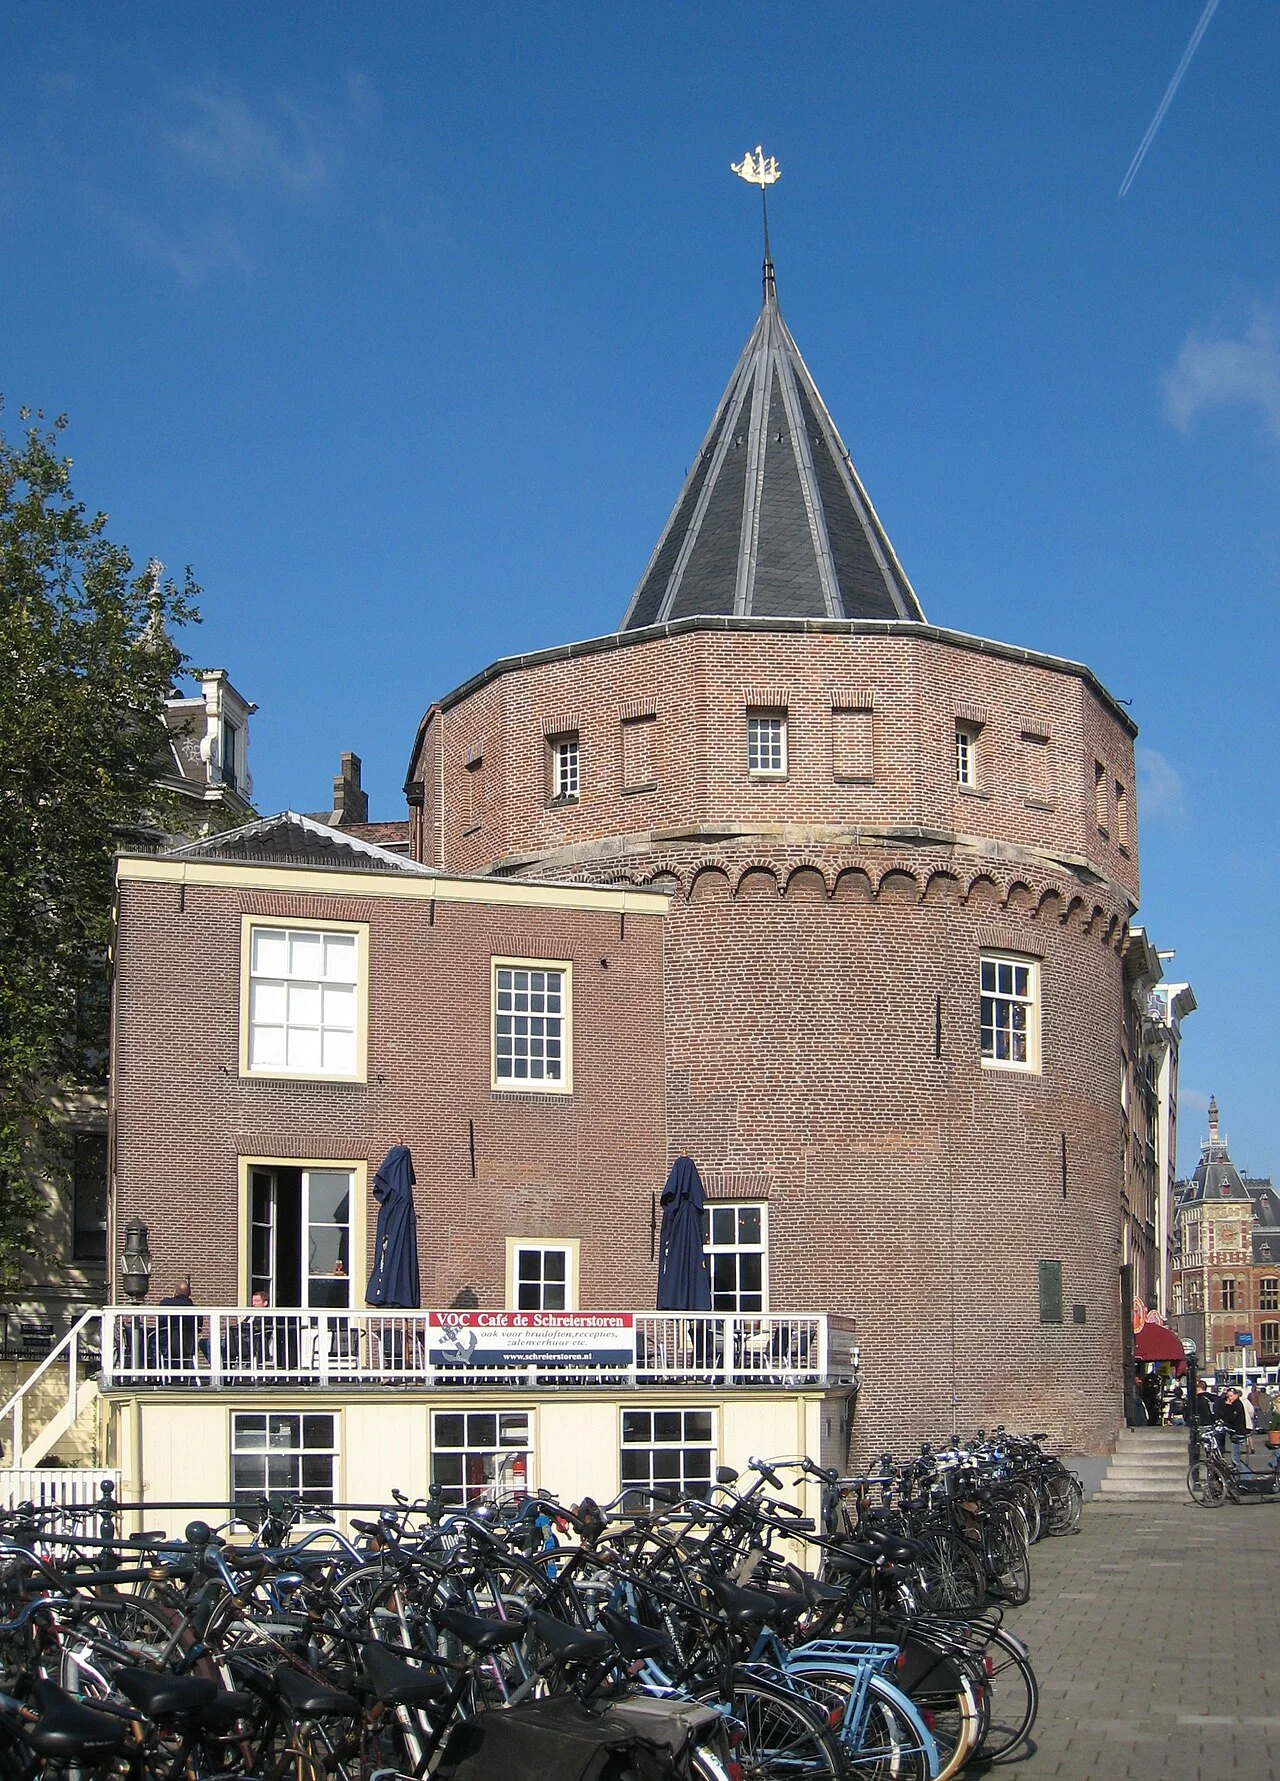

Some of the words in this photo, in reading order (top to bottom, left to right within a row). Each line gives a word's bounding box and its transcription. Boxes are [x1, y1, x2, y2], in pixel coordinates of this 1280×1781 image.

[436, 1313, 470, 1326] VOC
[477, 1313, 508, 1326] Café
[513, 1314, 528, 1326] de
[533, 1314, 624, 1327] Schreierstoren
[506, 1338, 570, 1346] zalenverhuur
[502, 1352, 592, 1361] www.schreierstoren.nl
